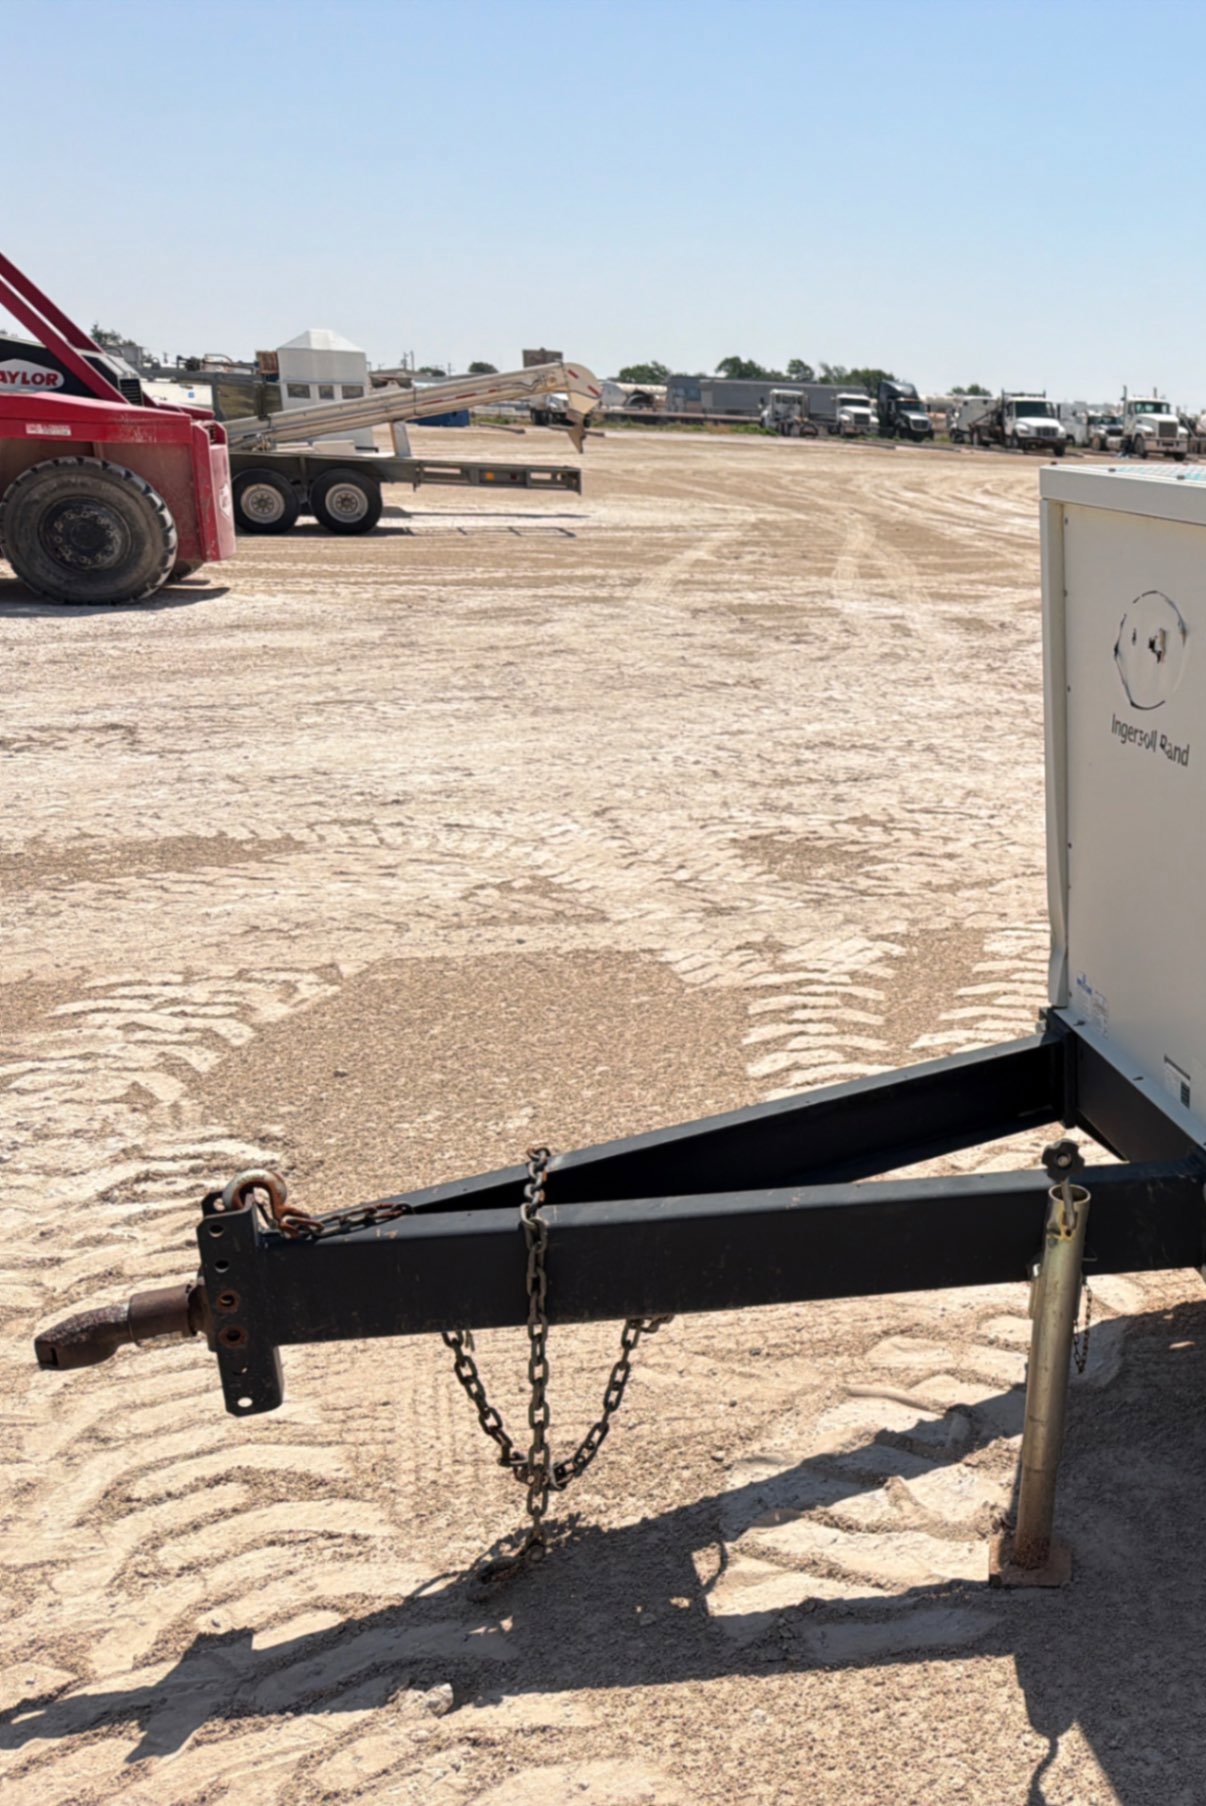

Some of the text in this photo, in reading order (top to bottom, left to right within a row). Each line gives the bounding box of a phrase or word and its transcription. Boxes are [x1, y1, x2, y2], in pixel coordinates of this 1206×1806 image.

[0, 370, 59, 387] AYLOR
[1111, 712, 1191, 768] Ingersoll Rand
